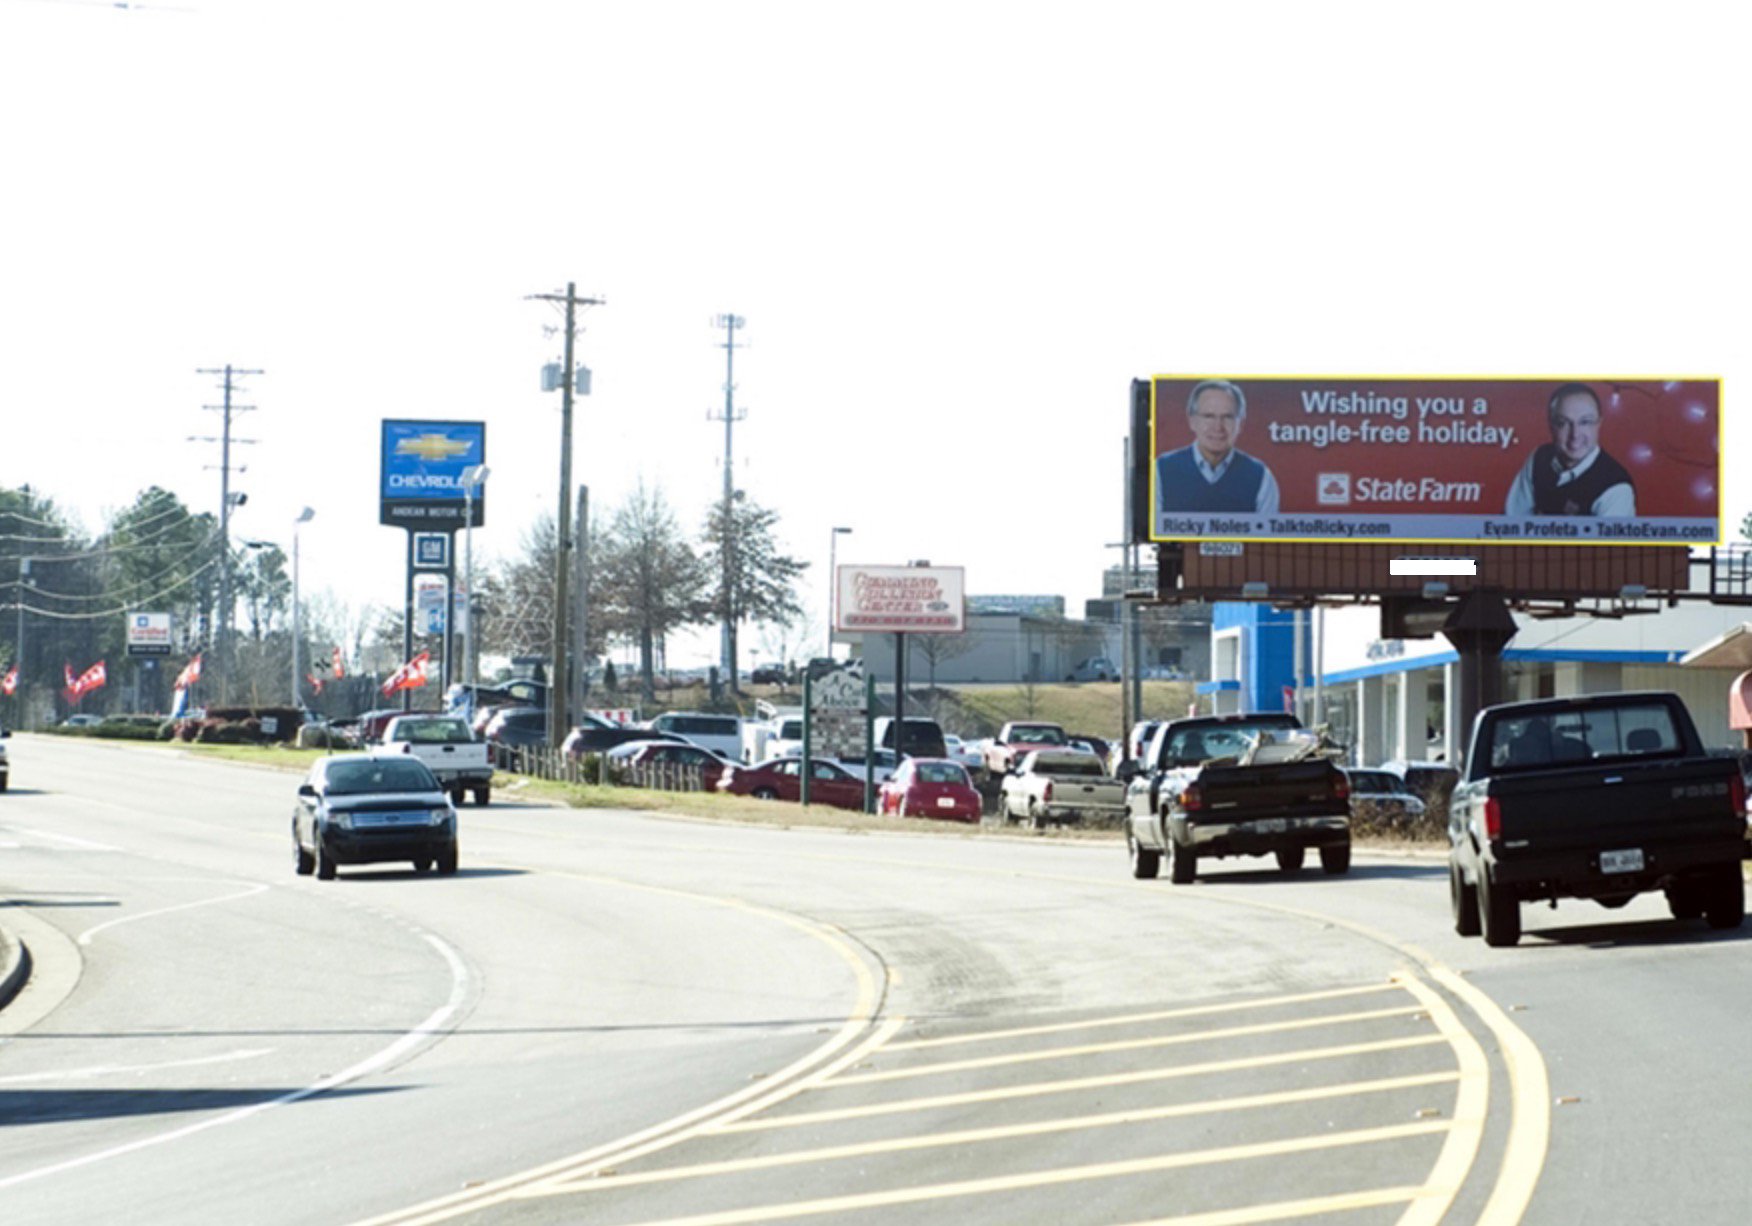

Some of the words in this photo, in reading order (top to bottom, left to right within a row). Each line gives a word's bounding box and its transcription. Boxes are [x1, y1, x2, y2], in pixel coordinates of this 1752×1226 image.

[1302, 391, 1408, 419] Wishing
[1416, 398, 1464, 417] you
[1472, 398, 1487, 415] a
[1268, 420, 1411, 447] tangle-free
[1418, 421, 1519, 448] holiday.
[1163, 518, 1205, 536] Ricky
[1209, 519, 1251, 534] Noles
[1269, 518, 1391, 537] TalktoRicky.com
[1484, 521, 1519, 537] Evan
[1525, 521, 1578, 537] Profeta
[1598, 521, 1714, 538] TalktoEvan.com
[1671, 782, 1728, 799] FORD
